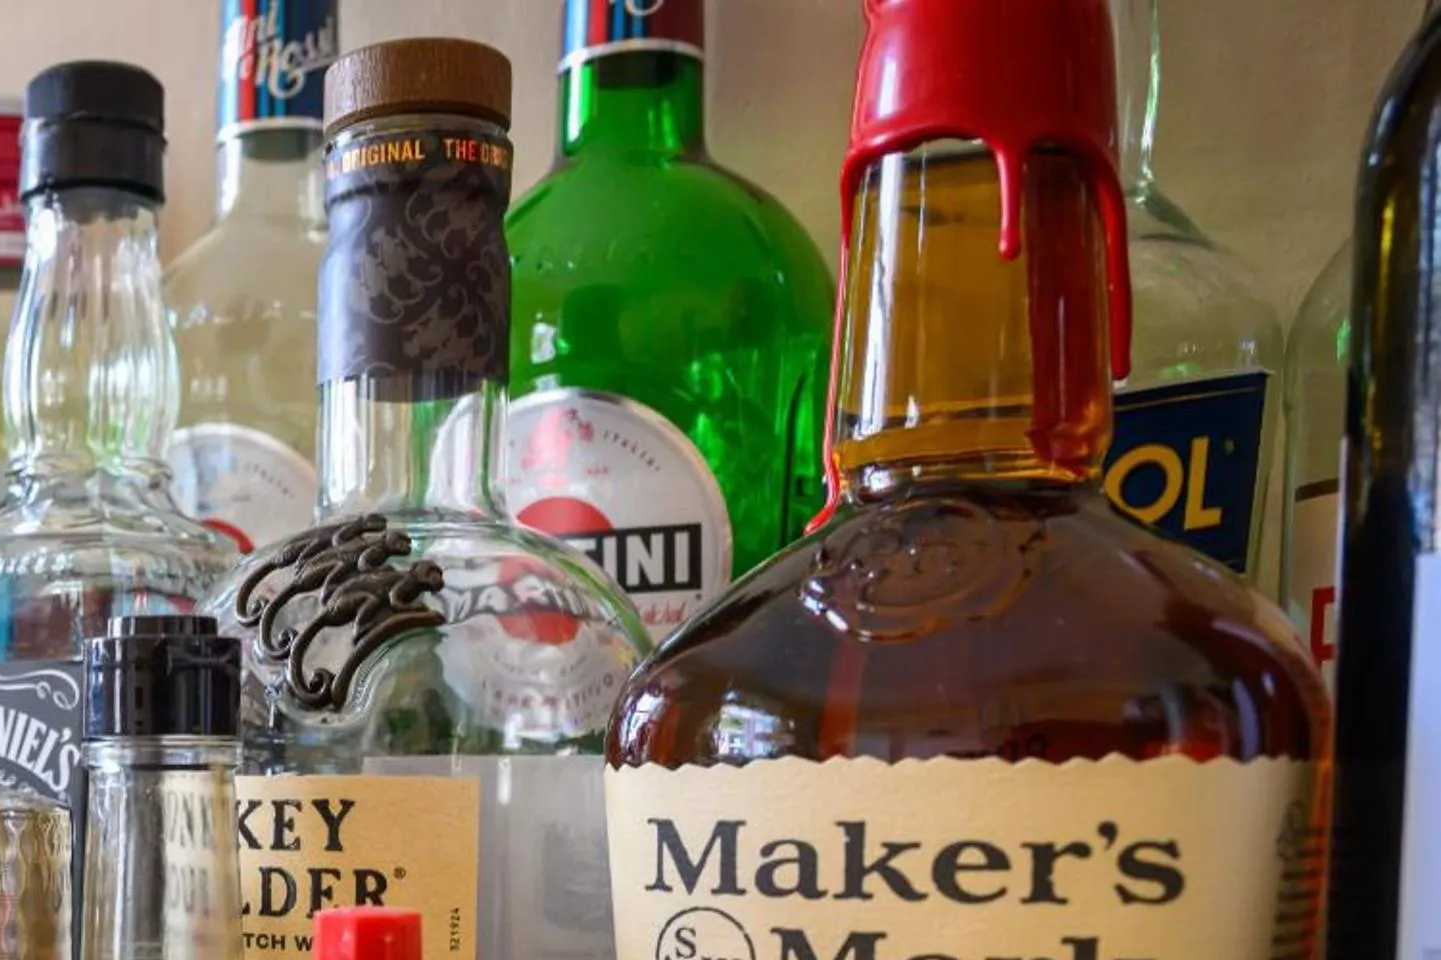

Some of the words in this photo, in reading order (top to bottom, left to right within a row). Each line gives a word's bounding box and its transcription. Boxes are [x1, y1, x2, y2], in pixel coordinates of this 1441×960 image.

[342, 139, 426, 173] ORIGINAL
[443, 139, 477, 160] THE
[235, 799, 356, 851] KEY
[645, 818, 1186, 906] Maker's
[242, 866, 388, 918] DER
[675, 927, 698, 960] S
